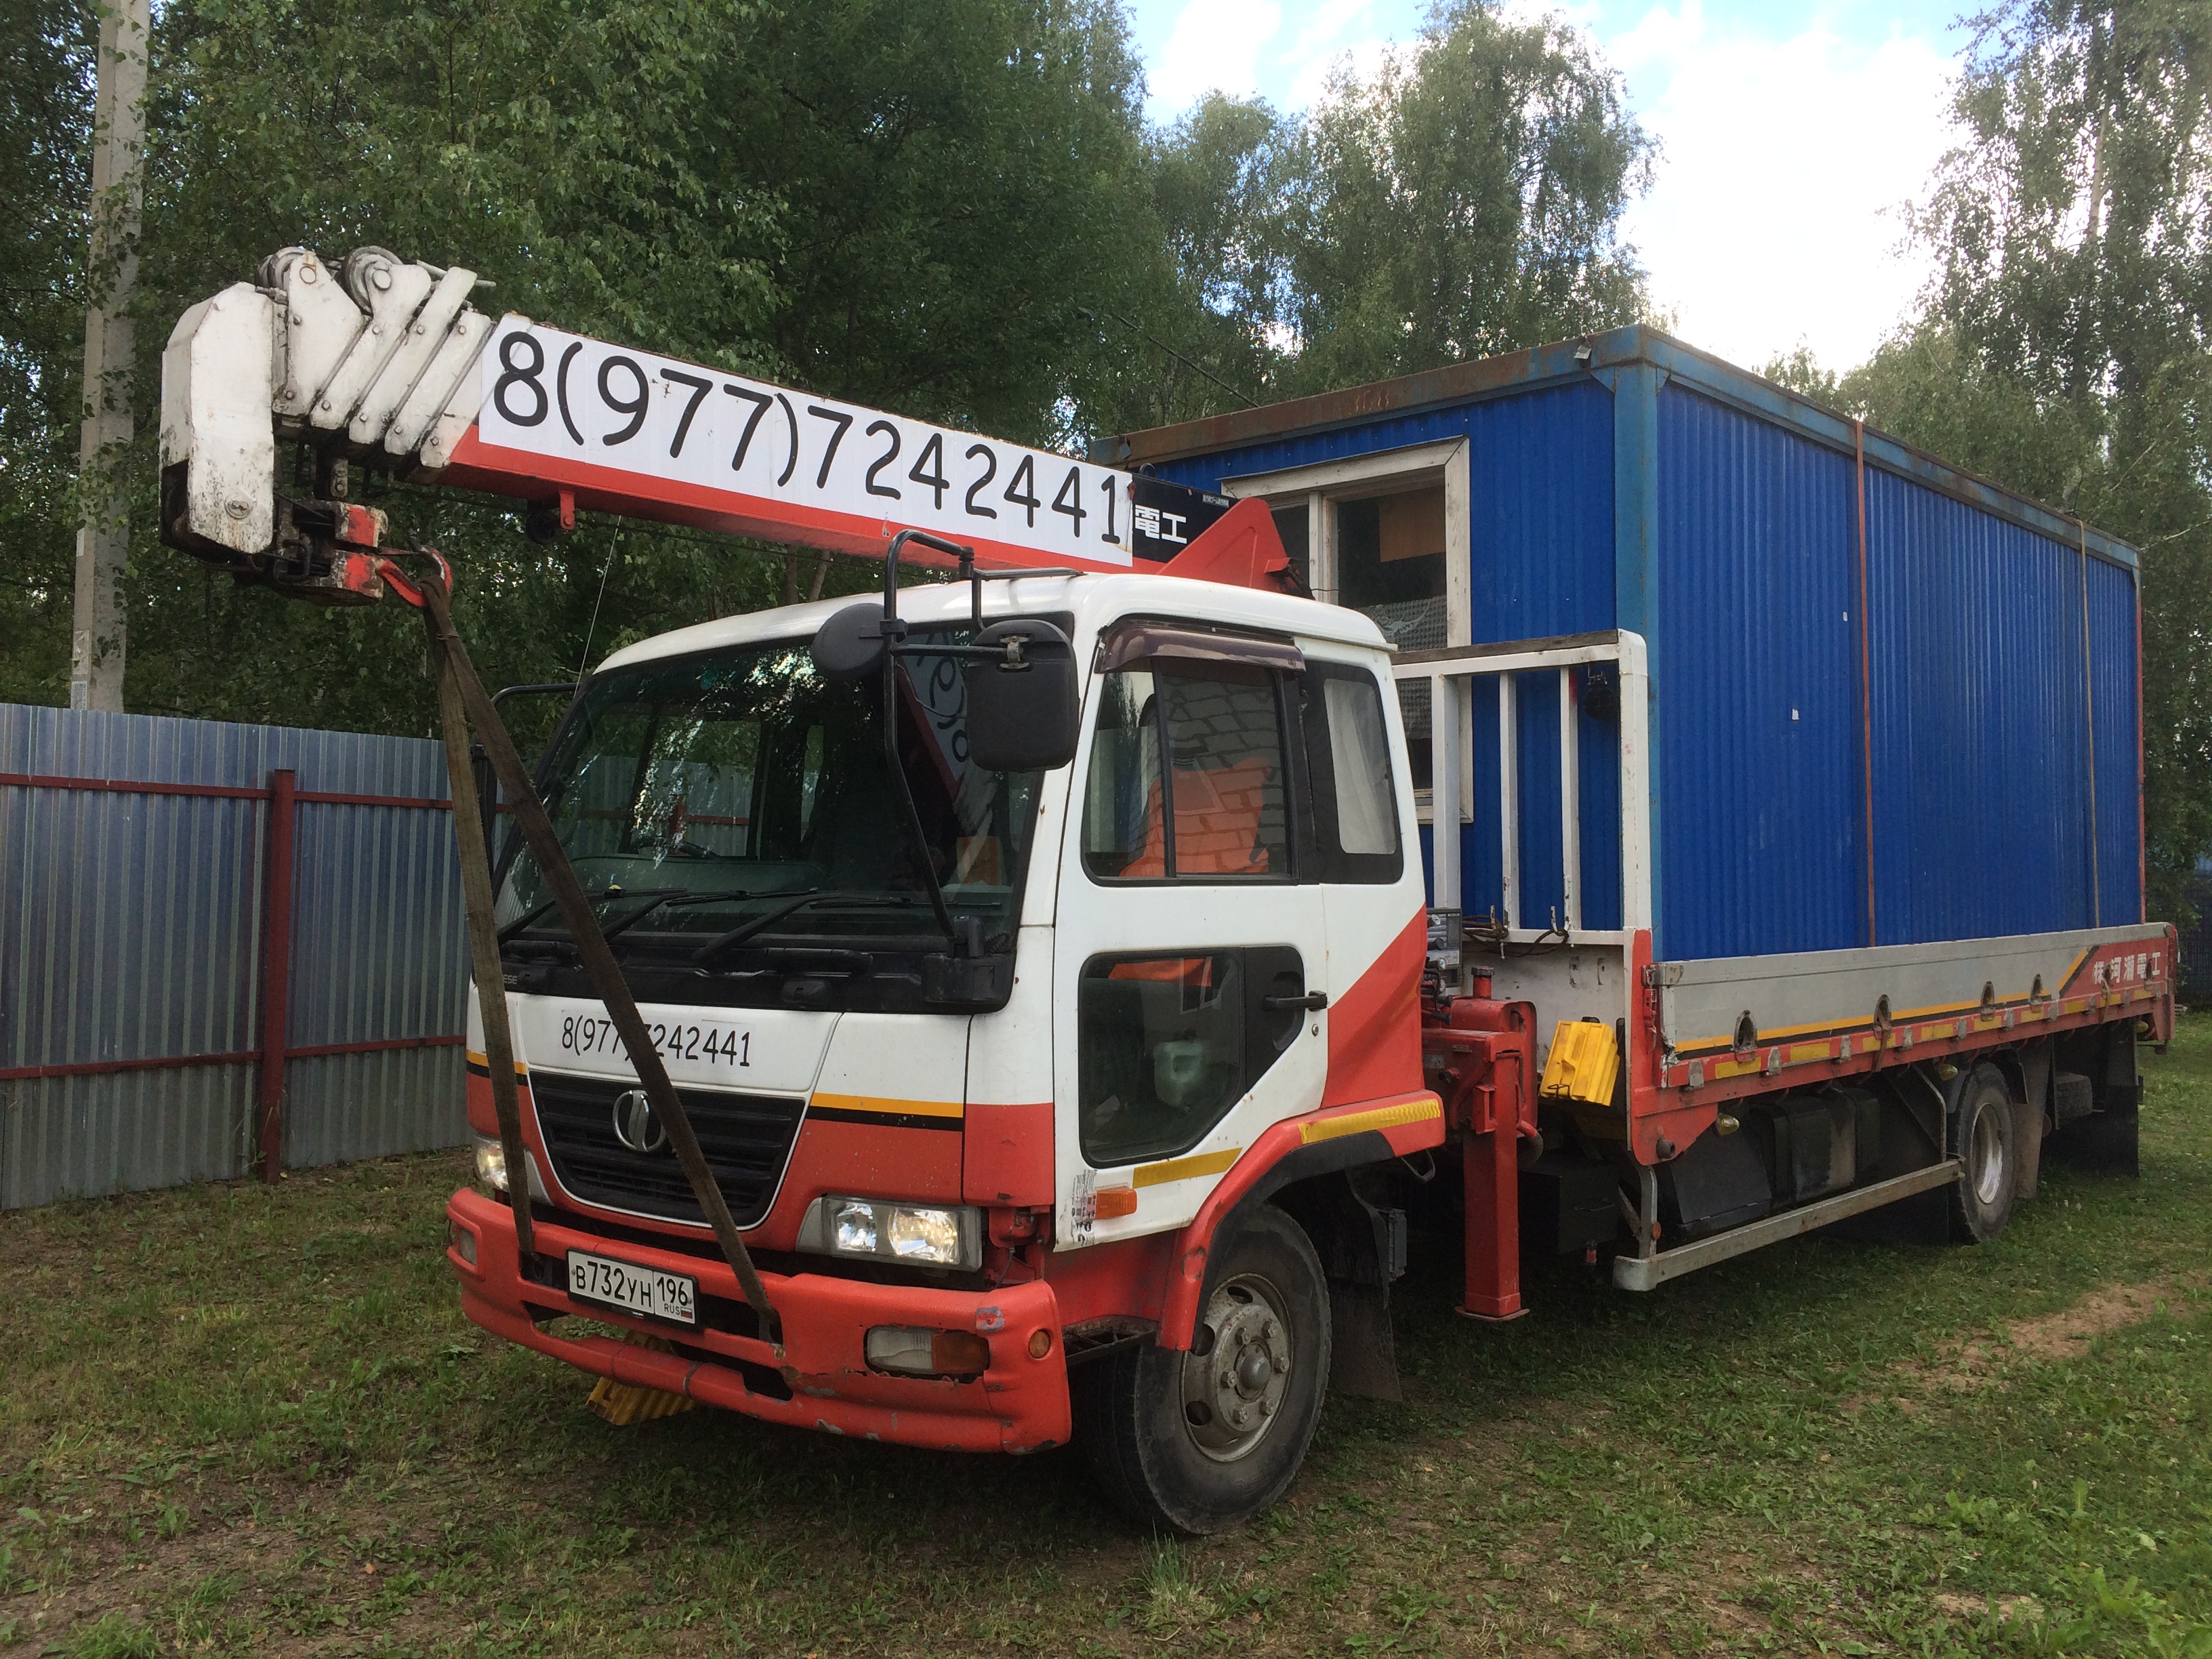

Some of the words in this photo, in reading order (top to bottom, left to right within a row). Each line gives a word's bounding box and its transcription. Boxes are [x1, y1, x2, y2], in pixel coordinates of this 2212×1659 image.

[494, 331, 1120, 544] 8(977)7242441
[1135, 505, 1187, 544] 電工
[664, 1303, 680, 1315] RUS
